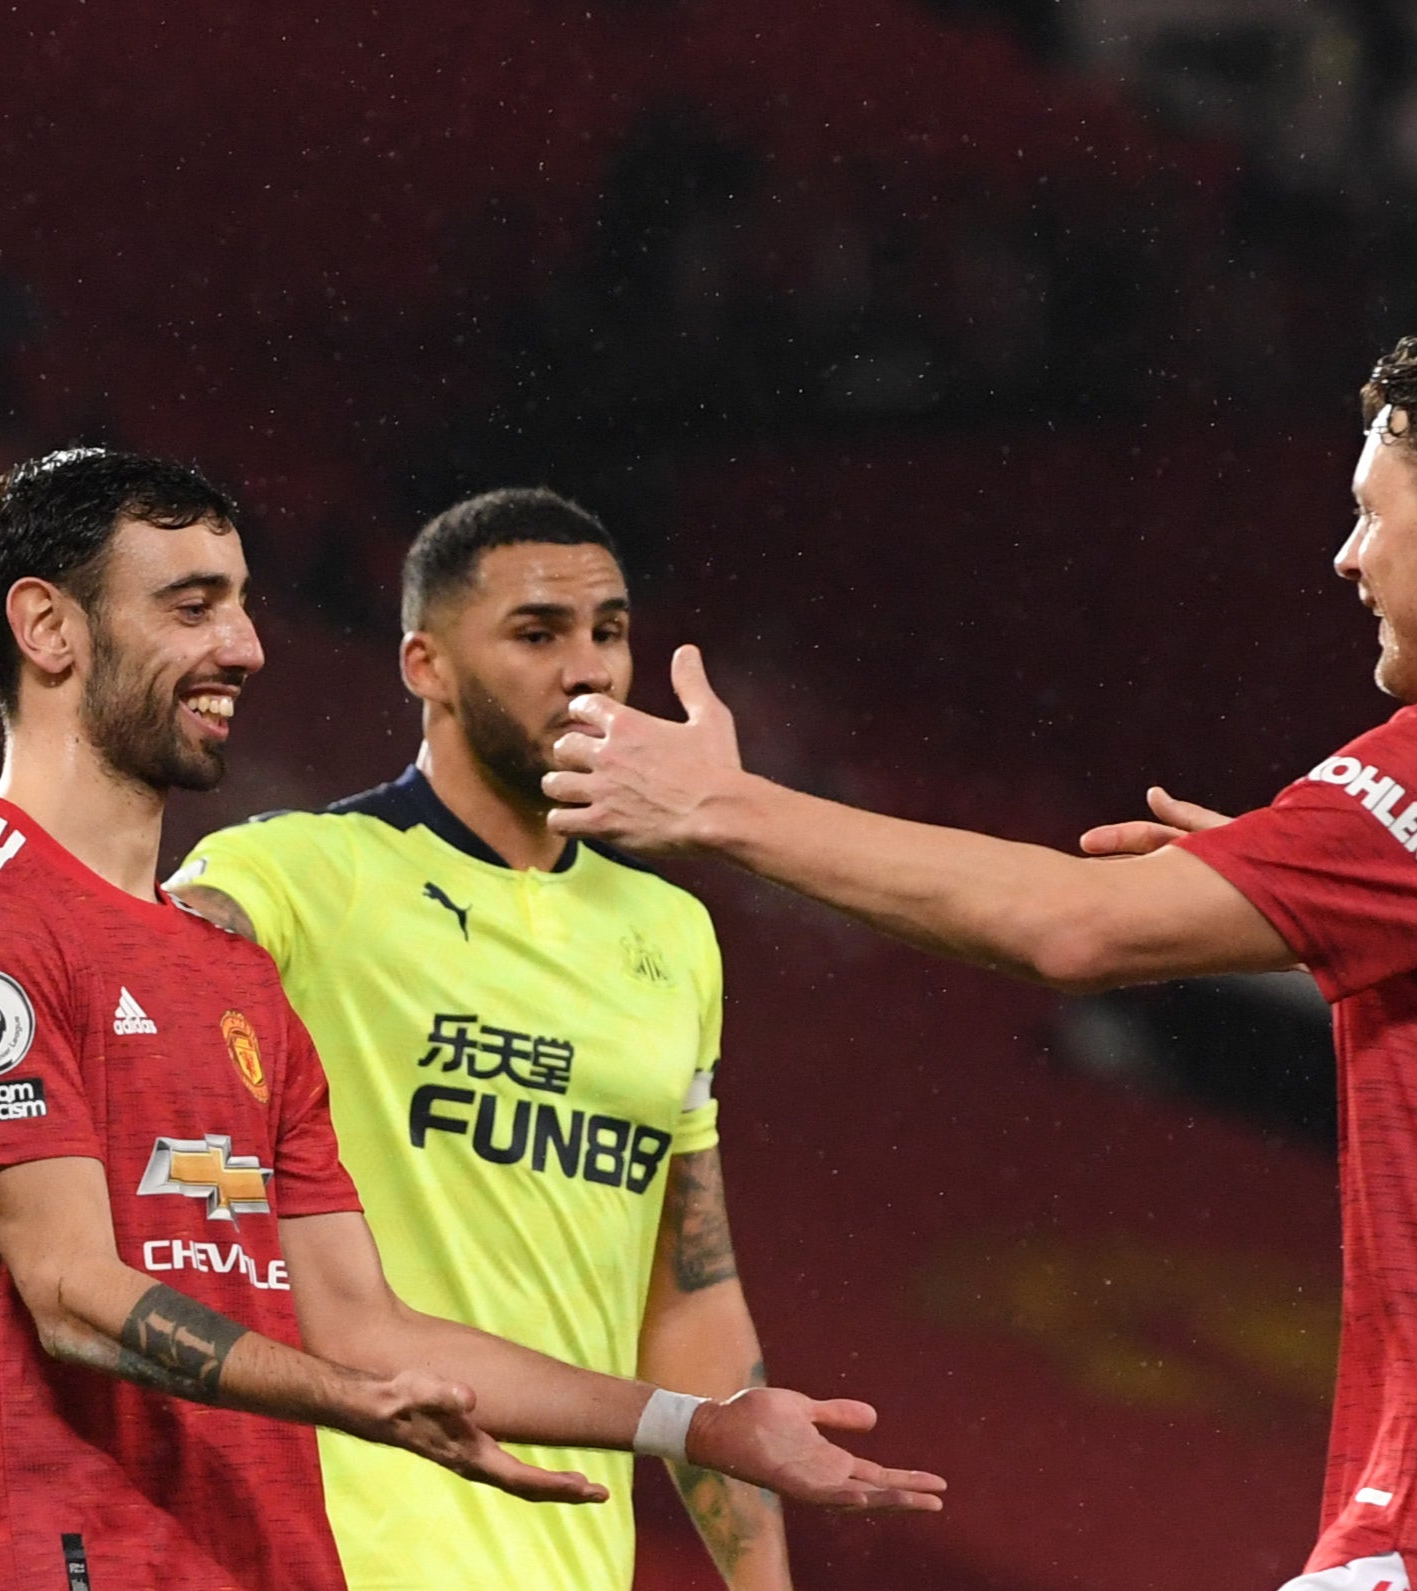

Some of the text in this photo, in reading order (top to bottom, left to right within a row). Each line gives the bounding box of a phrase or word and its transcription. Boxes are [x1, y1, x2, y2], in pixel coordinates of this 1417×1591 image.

[10, 1016, 22, 1048] League
[418, 1013, 574, 1095] 乐天堂
[409, 1083, 672, 1195] FUN88
